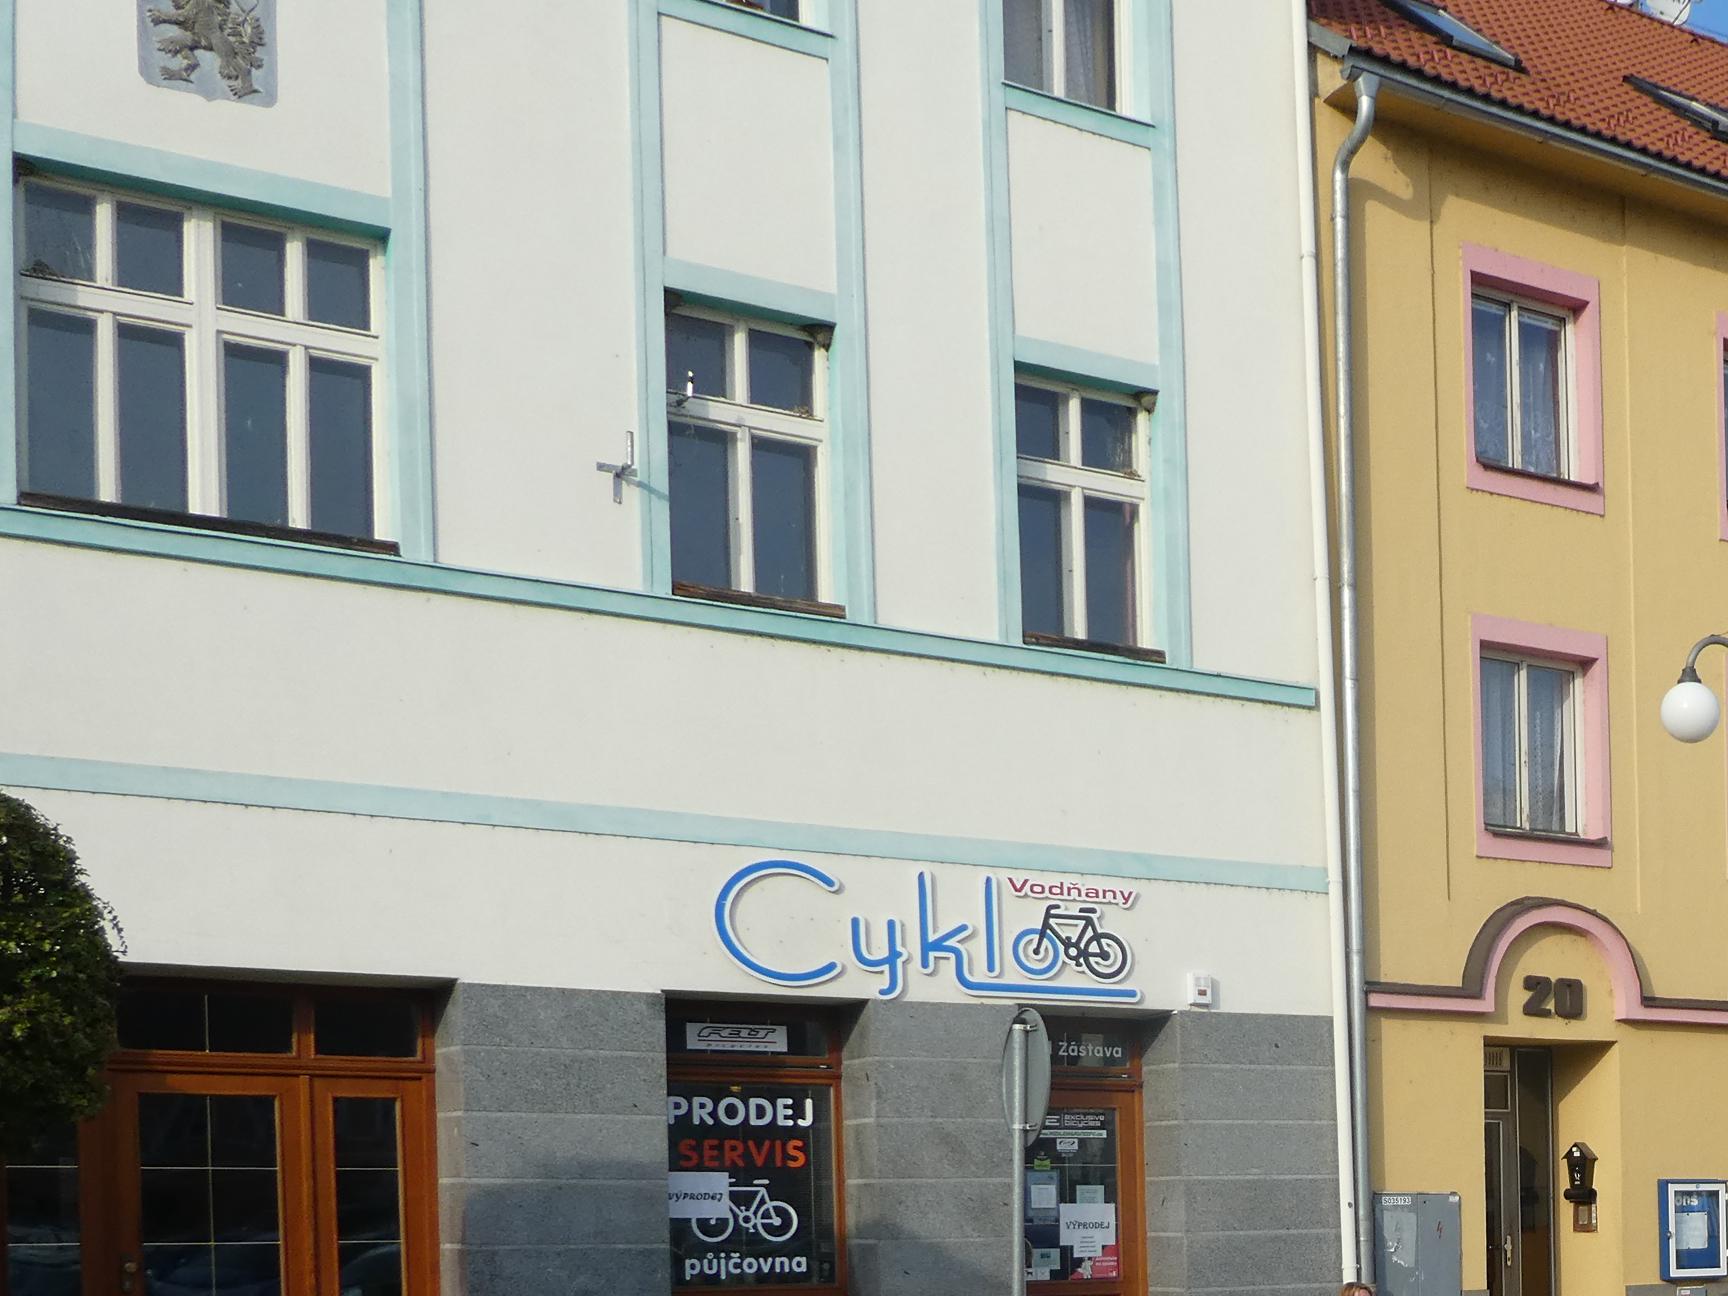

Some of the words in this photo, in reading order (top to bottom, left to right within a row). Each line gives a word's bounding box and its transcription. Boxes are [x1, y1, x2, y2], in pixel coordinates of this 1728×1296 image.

[1008, 876, 1136, 905] Vodňany
[1523, 974, 1584, 1020] 20
[697, 1025, 777, 1040] FELT
[1058, 1041, 1122, 1058] Zástava
[666, 1096, 814, 1127] PRODEJ
[678, 1138, 808, 1169] SERVIS
[667, 1192, 724, 1202] VÝPRODEJ
[1065, 1220, 1110, 1230] VÝPRODEJ
[685, 1252, 808, 1281] půjčovna
